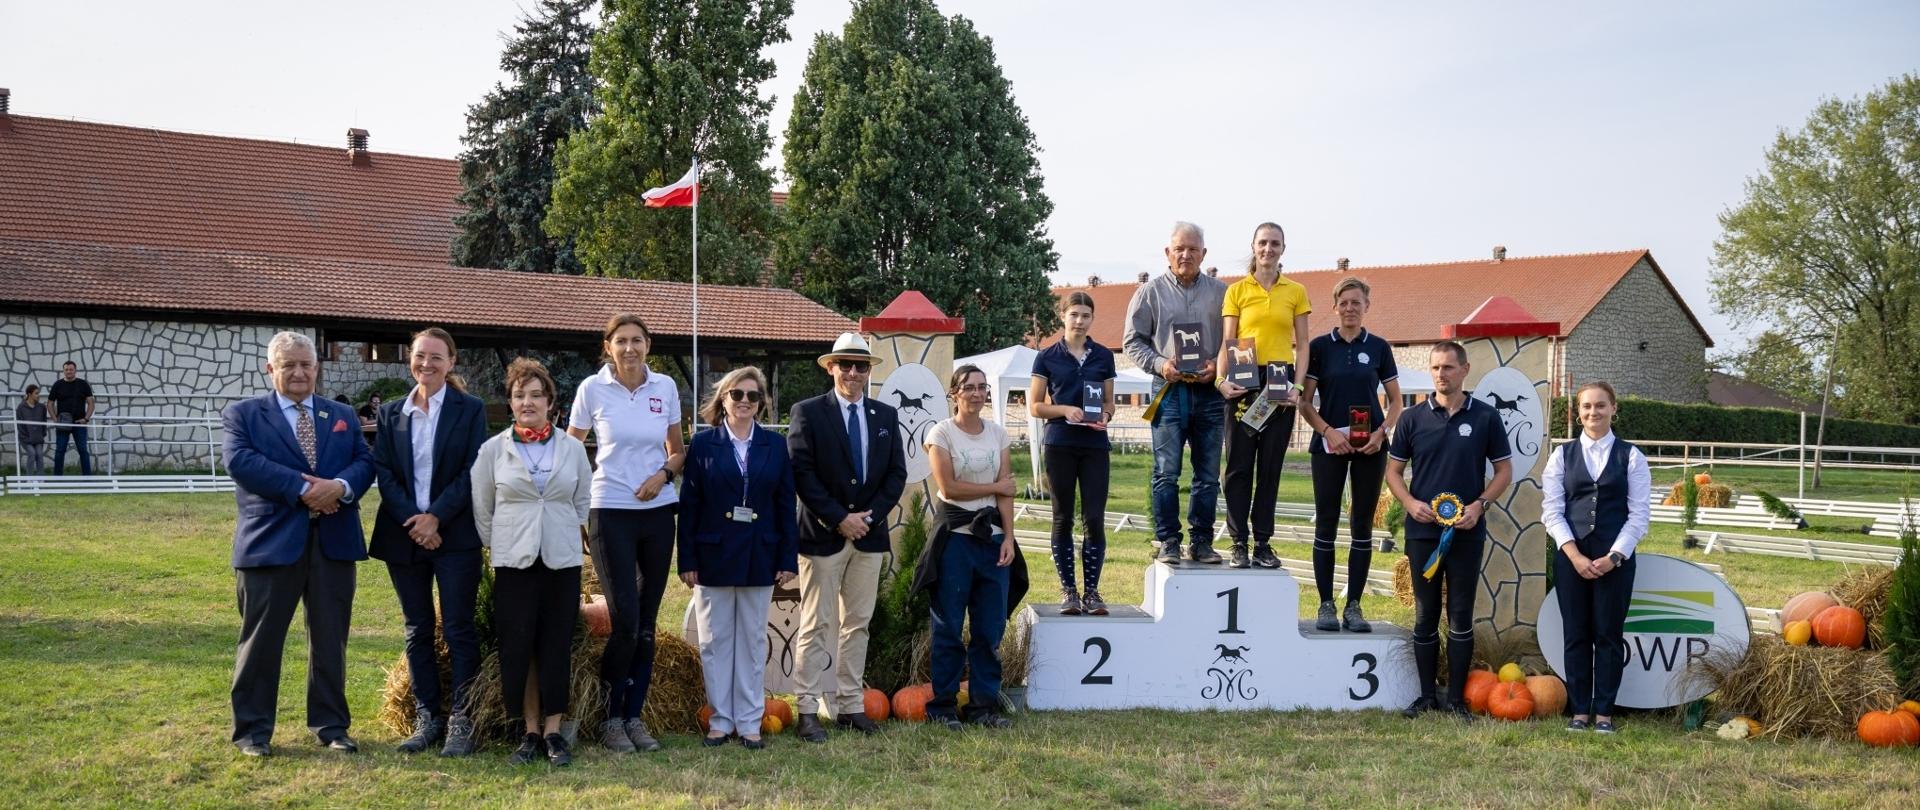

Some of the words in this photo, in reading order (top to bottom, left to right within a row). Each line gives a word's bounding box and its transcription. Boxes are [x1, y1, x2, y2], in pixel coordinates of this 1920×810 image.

[1216, 586, 1246, 634] 1
[1080, 636, 1113, 685] 2
[1348, 652, 1380, 701] 3
[1622, 636, 1711, 672] WR
